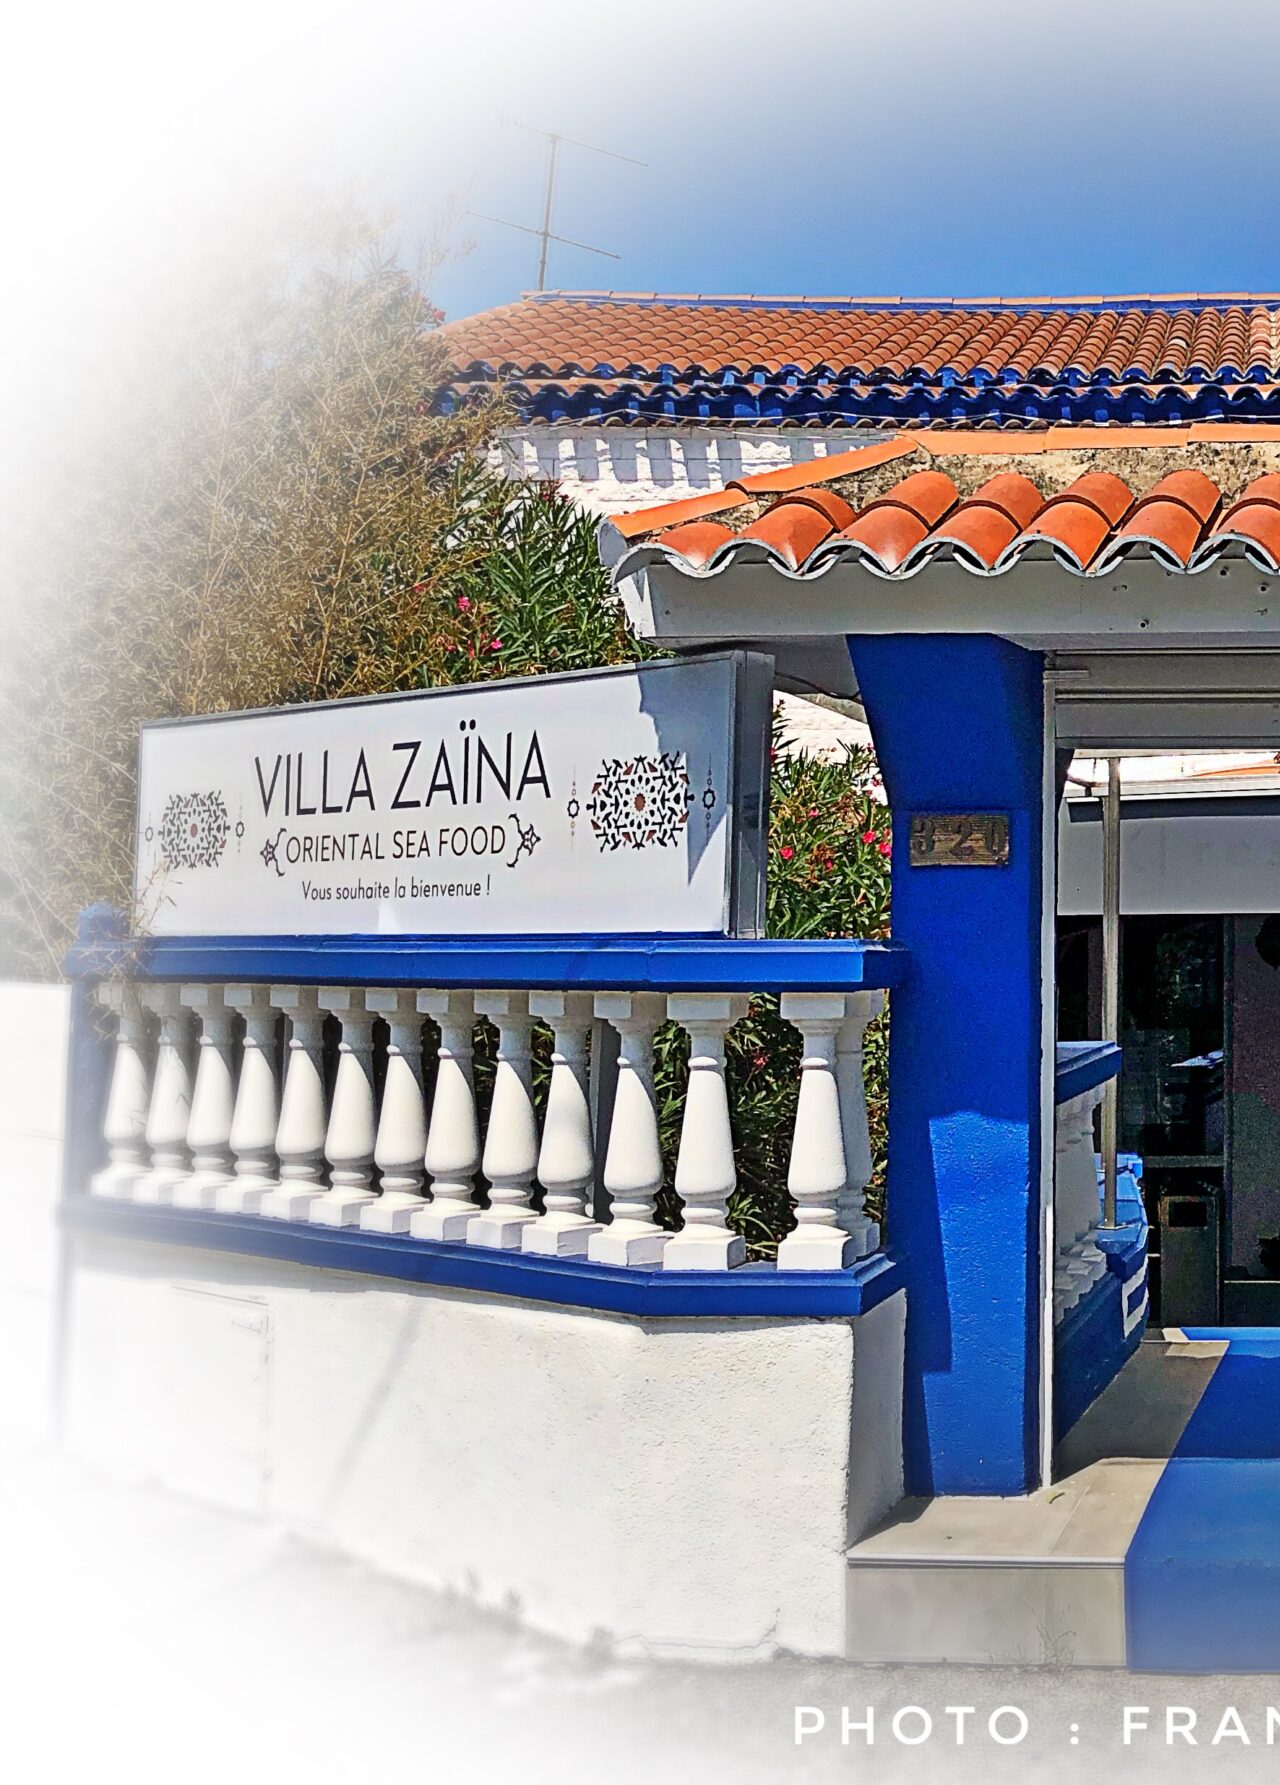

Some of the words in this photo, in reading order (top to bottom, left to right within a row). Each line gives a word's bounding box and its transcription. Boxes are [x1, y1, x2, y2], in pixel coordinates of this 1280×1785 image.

[254, 747, 376, 818] VILLA
[390, 718, 552, 811] ZAÏNA
[285, 832, 386, 864] ORIENTAL
[392, 830, 431, 860] SEA
[438, 825, 507, 857] FOOD
[301, 880, 332, 902] Vous
[335, 878, 390, 901] souhaite
[394, 876, 406, 899] la
[410, 876, 482, 898] bienvenue
